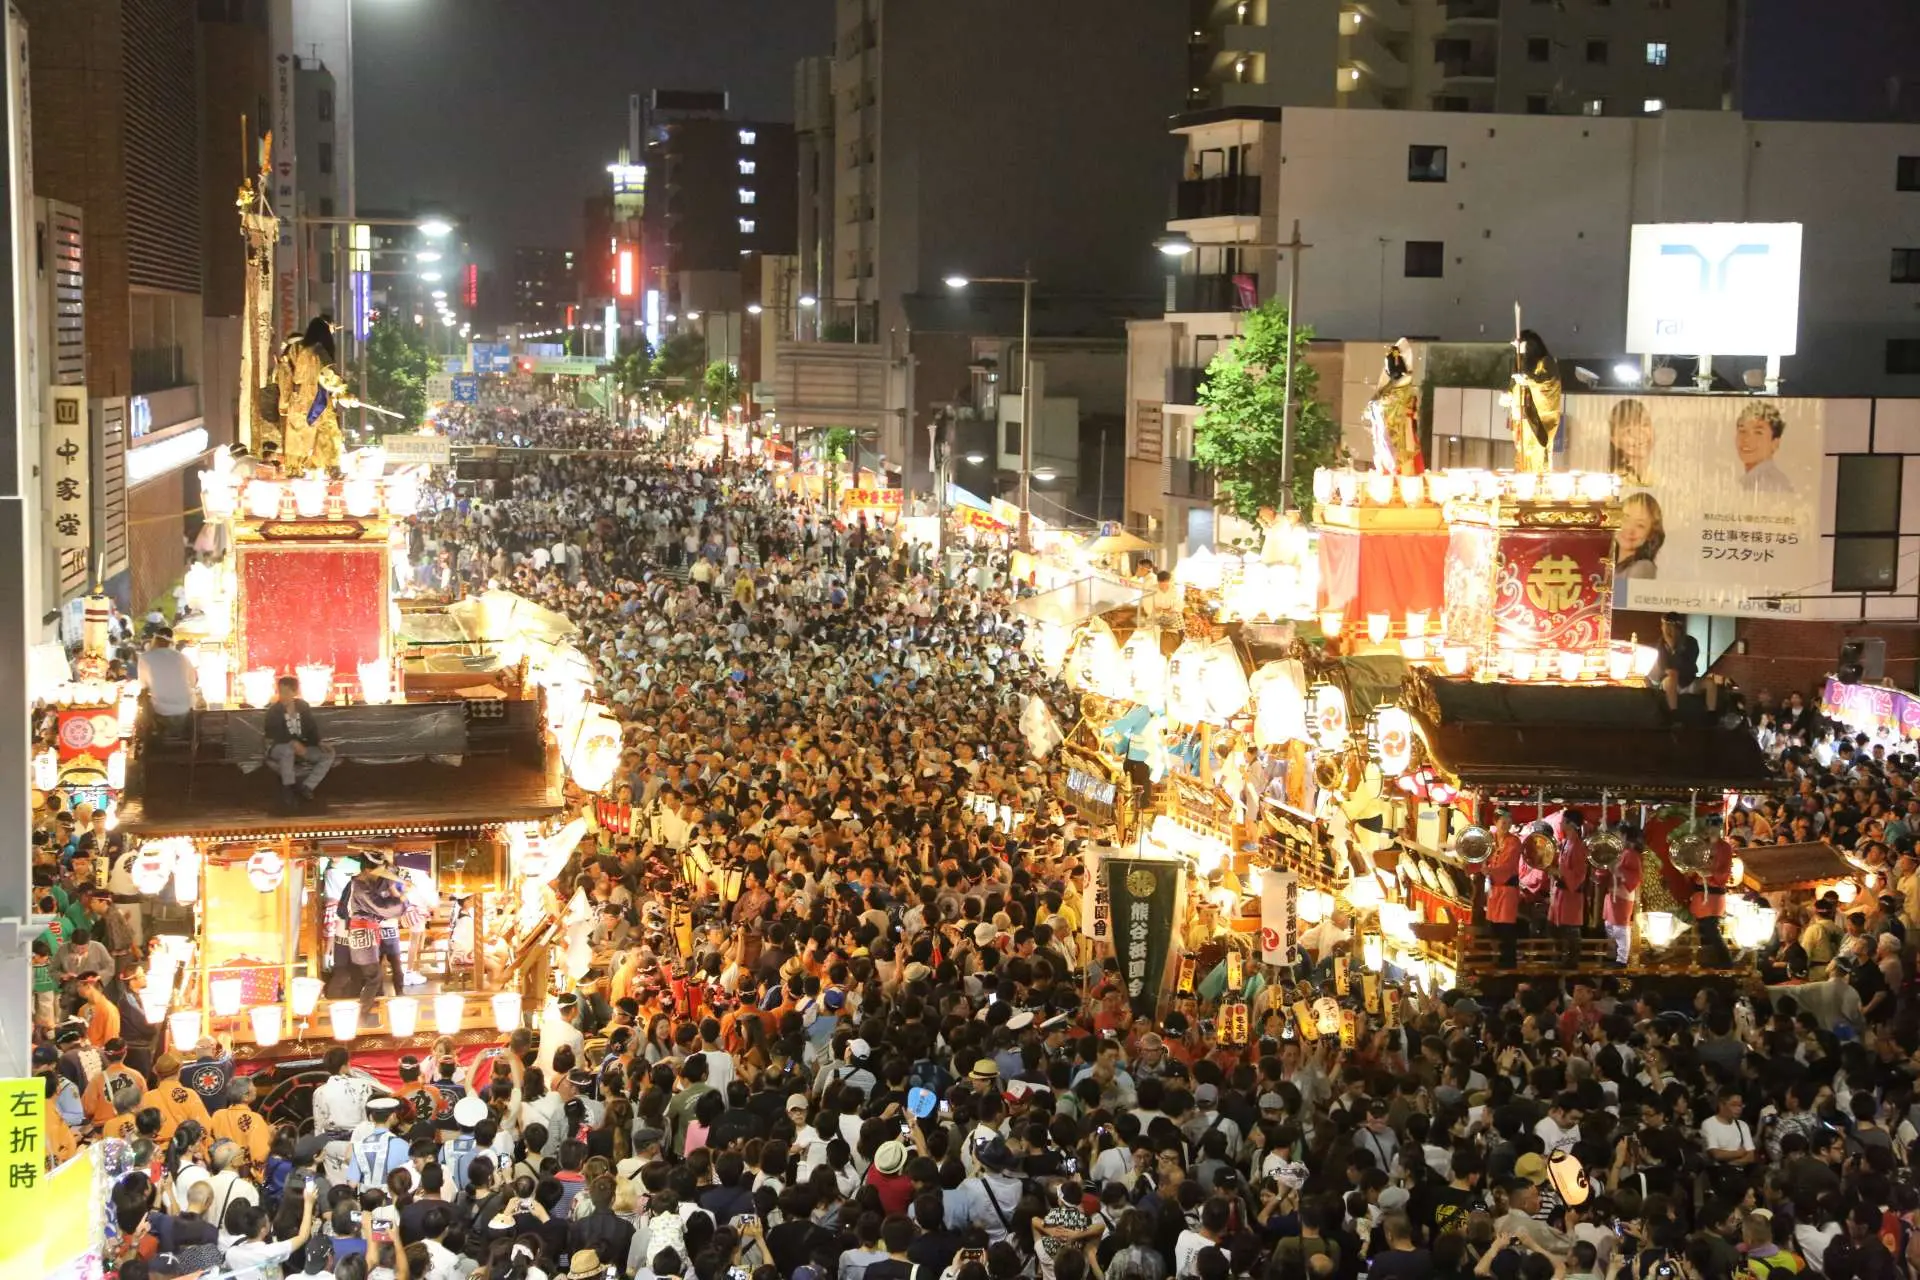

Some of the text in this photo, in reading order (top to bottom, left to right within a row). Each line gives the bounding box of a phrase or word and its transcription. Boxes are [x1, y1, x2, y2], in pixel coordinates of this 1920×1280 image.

[55, 437, 81, 537] 中家堂
[1701, 529, 1799, 545] お仕事を探すなら
[1701, 546, 1775, 563] ランスタッド
[9, 1090, 39, 1188] 左折時
